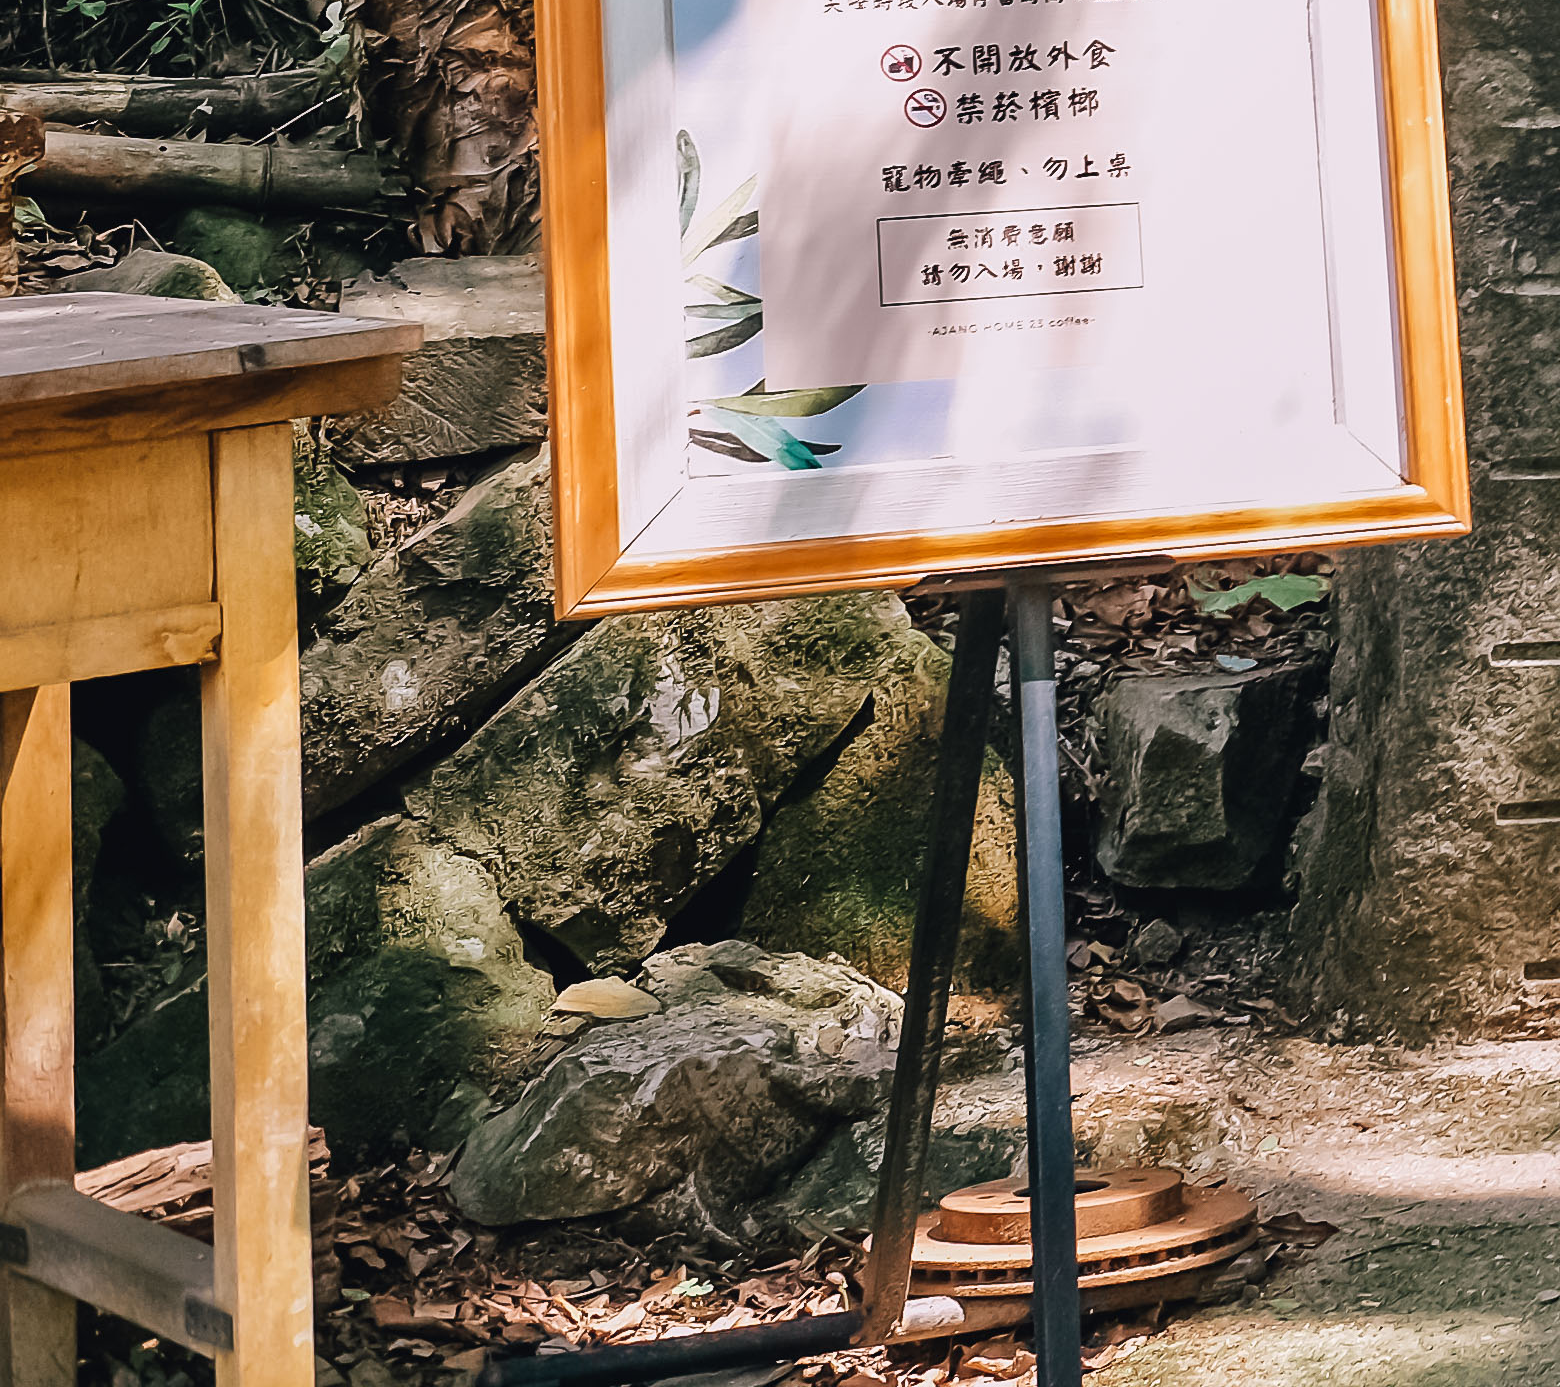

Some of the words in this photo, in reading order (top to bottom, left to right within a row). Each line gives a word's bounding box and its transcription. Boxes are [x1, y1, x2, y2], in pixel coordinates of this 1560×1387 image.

[931, 39, 1117, 77] 不開放外食
[955, 87, 1100, 125] 禁菸檳榔
[881, 152, 1132, 194] 寵物牽繩、勿上桌
[946, 221, 1076, 250] 無消費意願
